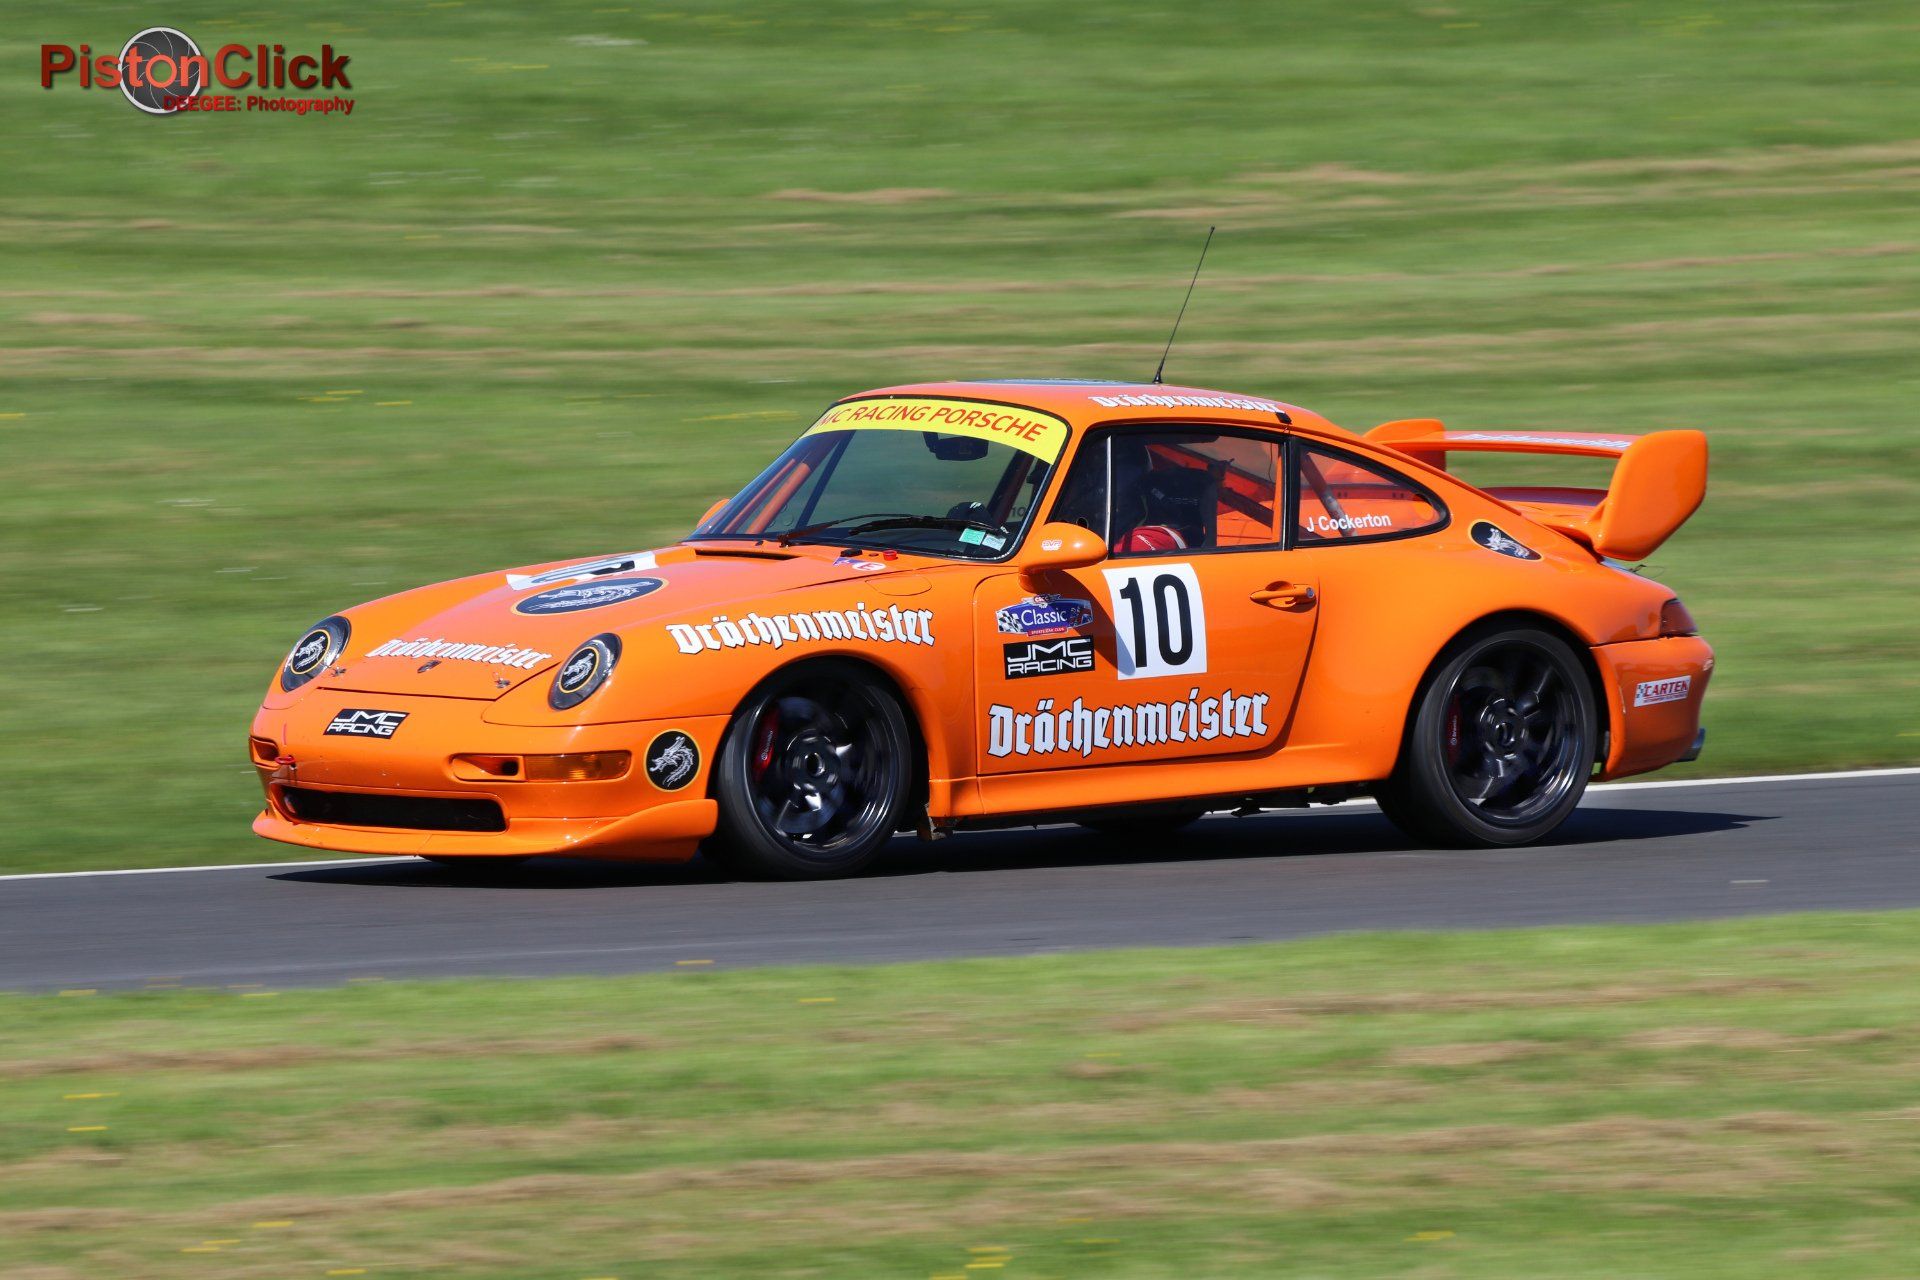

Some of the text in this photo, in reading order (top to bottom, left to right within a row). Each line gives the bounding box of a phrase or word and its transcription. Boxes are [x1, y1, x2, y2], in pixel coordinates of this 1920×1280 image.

[847, 405, 931, 421] RACING
[928, 407, 1048, 442] PORSCHE
[1307, 514, 1392, 532] J Cockerton
[1020, 607, 1068, 627] Classic
[1119, 573, 1194, 669] 10
[666, 602, 935, 655] Drächenmeister
[1007, 638, 1092, 663] JMC
[1008, 656, 1092, 675] RACING
[326, 722, 396, 736] RACING
[333, 710, 407, 727] JMC
[987, 687, 1270, 758] Drächenmeister
